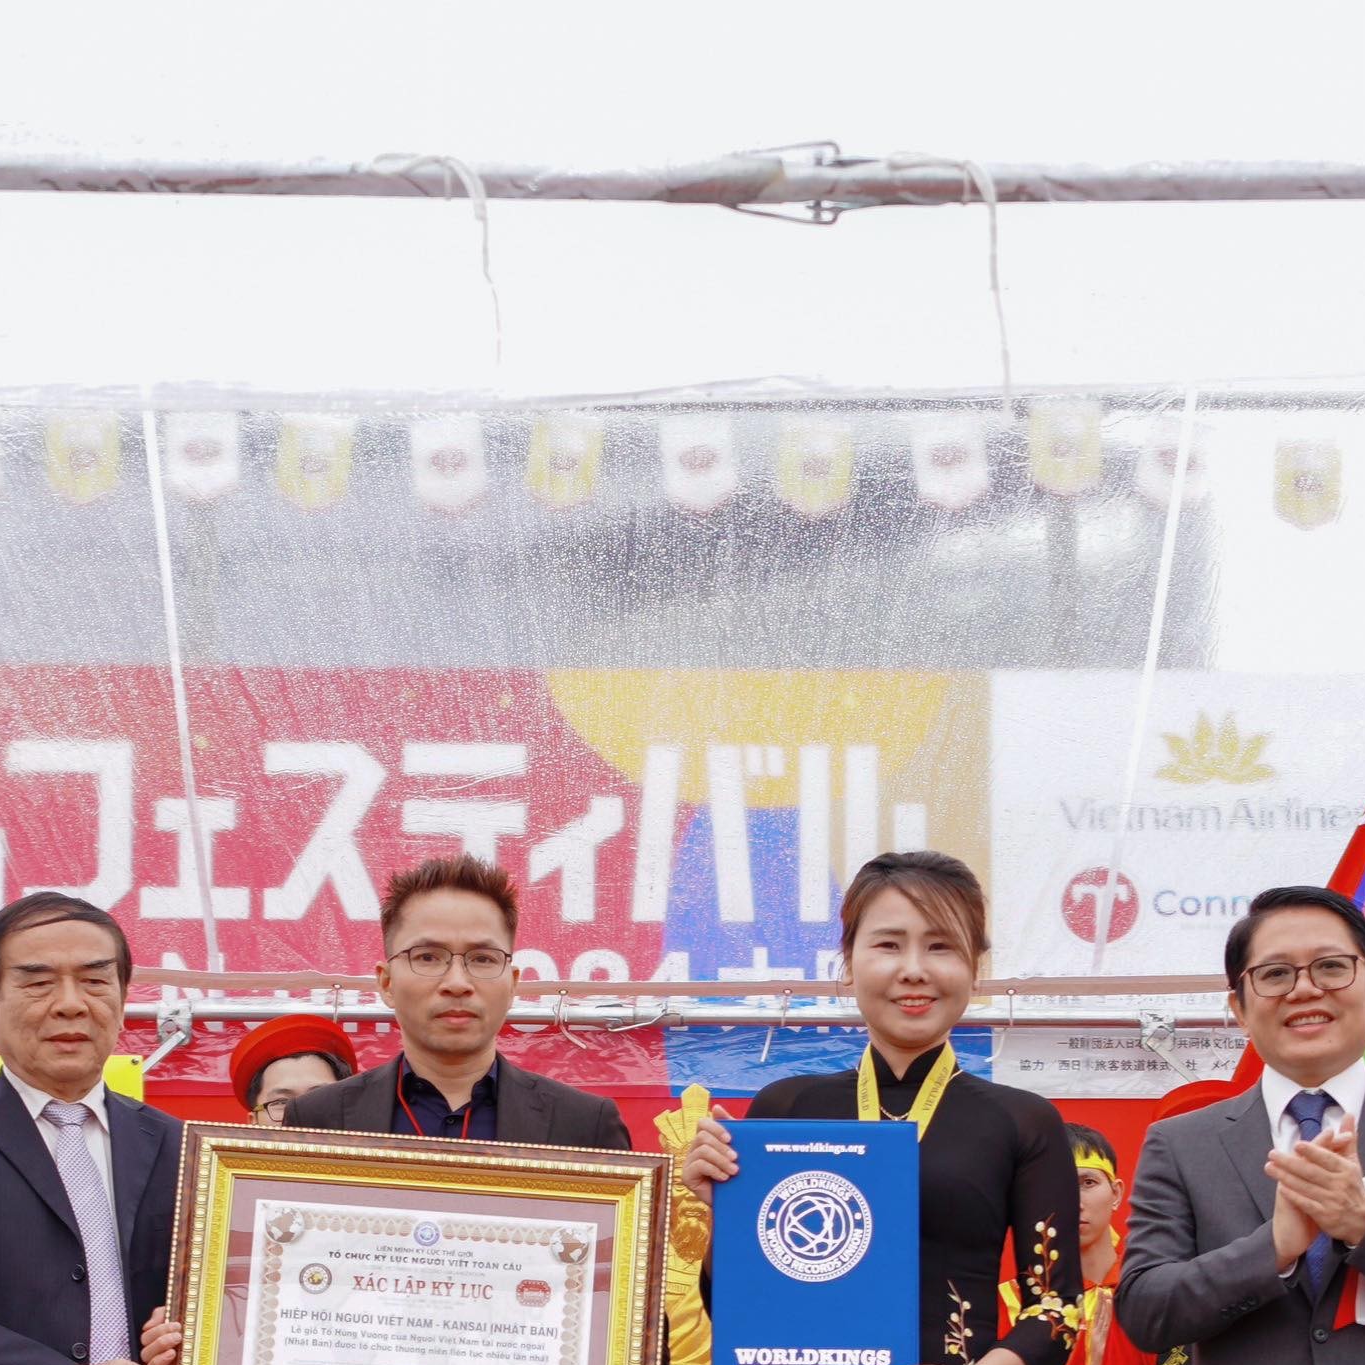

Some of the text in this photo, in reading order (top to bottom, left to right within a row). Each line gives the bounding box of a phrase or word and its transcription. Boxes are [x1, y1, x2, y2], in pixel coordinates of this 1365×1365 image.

[765, 1141, 866, 1156] www.worldkings.org
[778, 1178, 853, 1202] WORLDKINGS
[765, 1228, 864, 1275] WORLD RECORDS UNION
[352, 1272, 388, 1292] XÁC
[393, 1275, 426, 1298] LẬP
[406, 1317, 433, 1329] NAM
[443, 1319, 486, 1332] KANSAI
